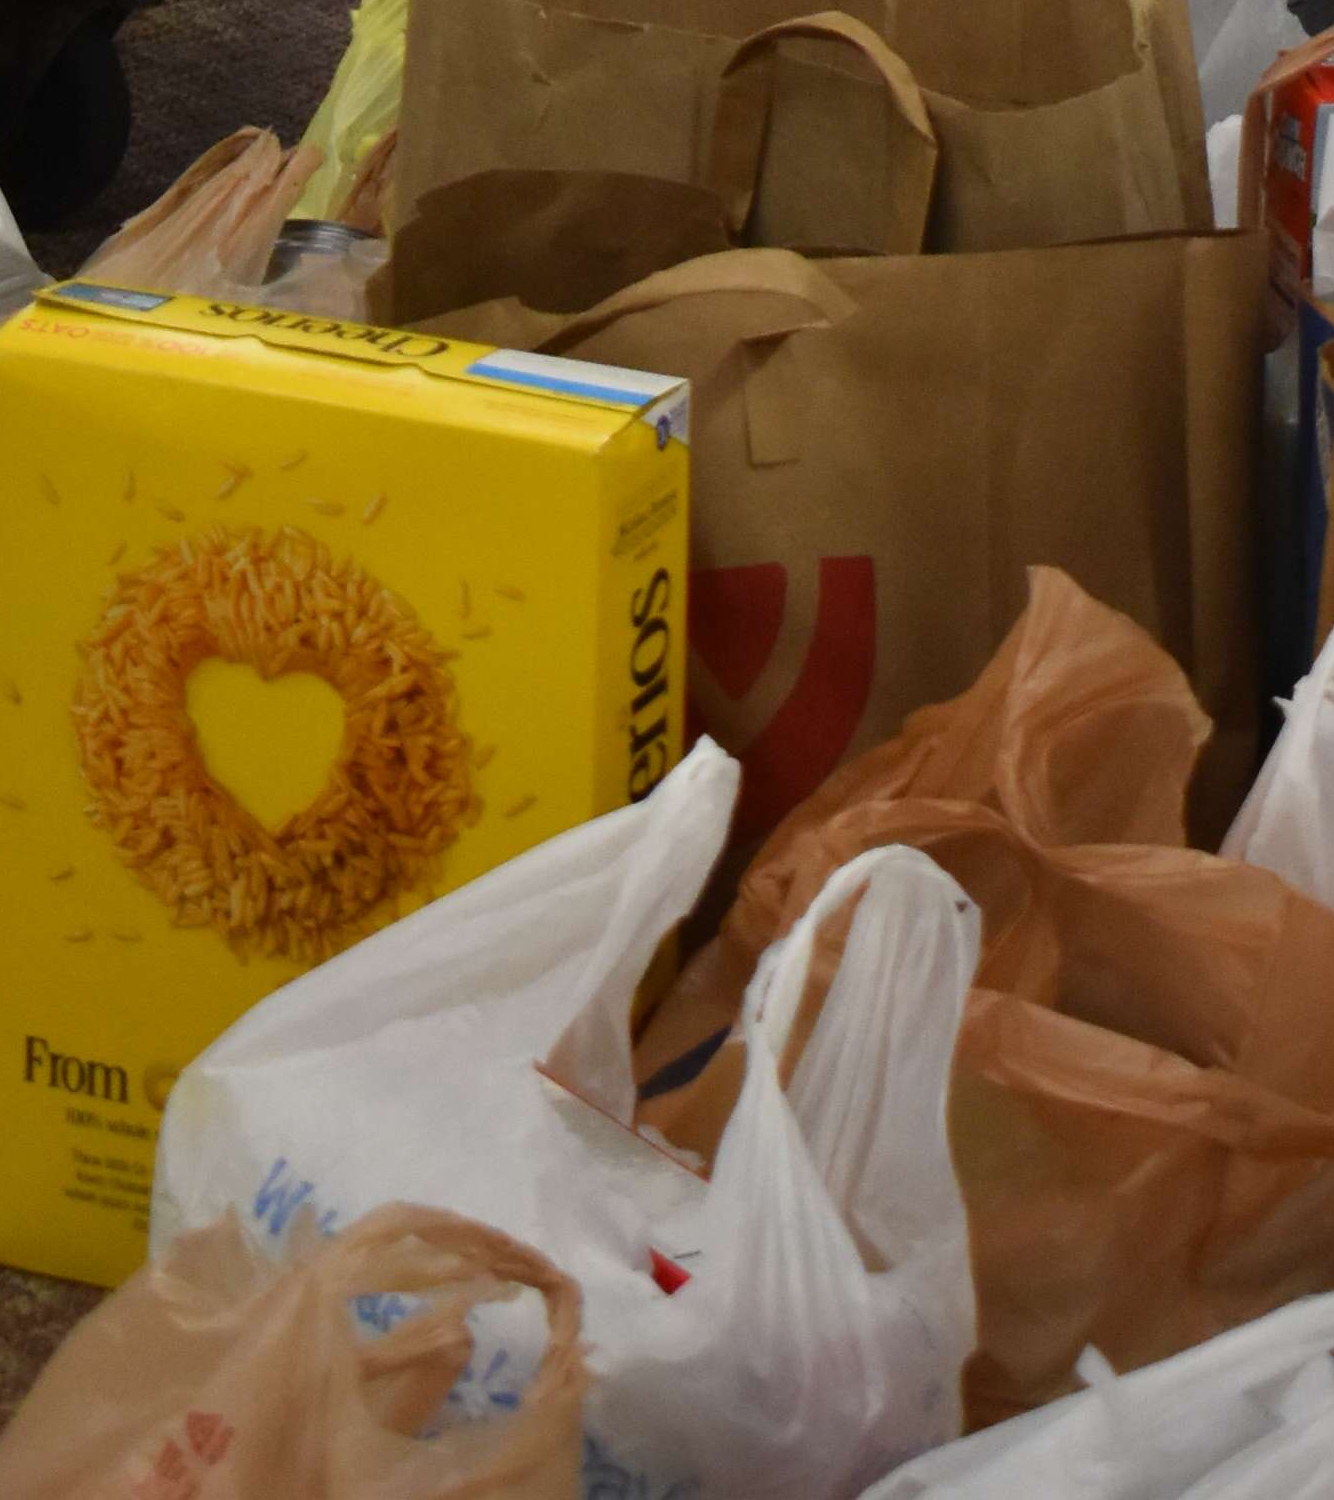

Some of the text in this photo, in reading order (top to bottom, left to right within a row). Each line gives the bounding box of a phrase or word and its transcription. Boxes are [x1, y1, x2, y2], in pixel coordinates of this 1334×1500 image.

[202, 302, 450, 357] Cheerios
[629, 567, 671, 805] erios
[25, 1035, 130, 1104] From
